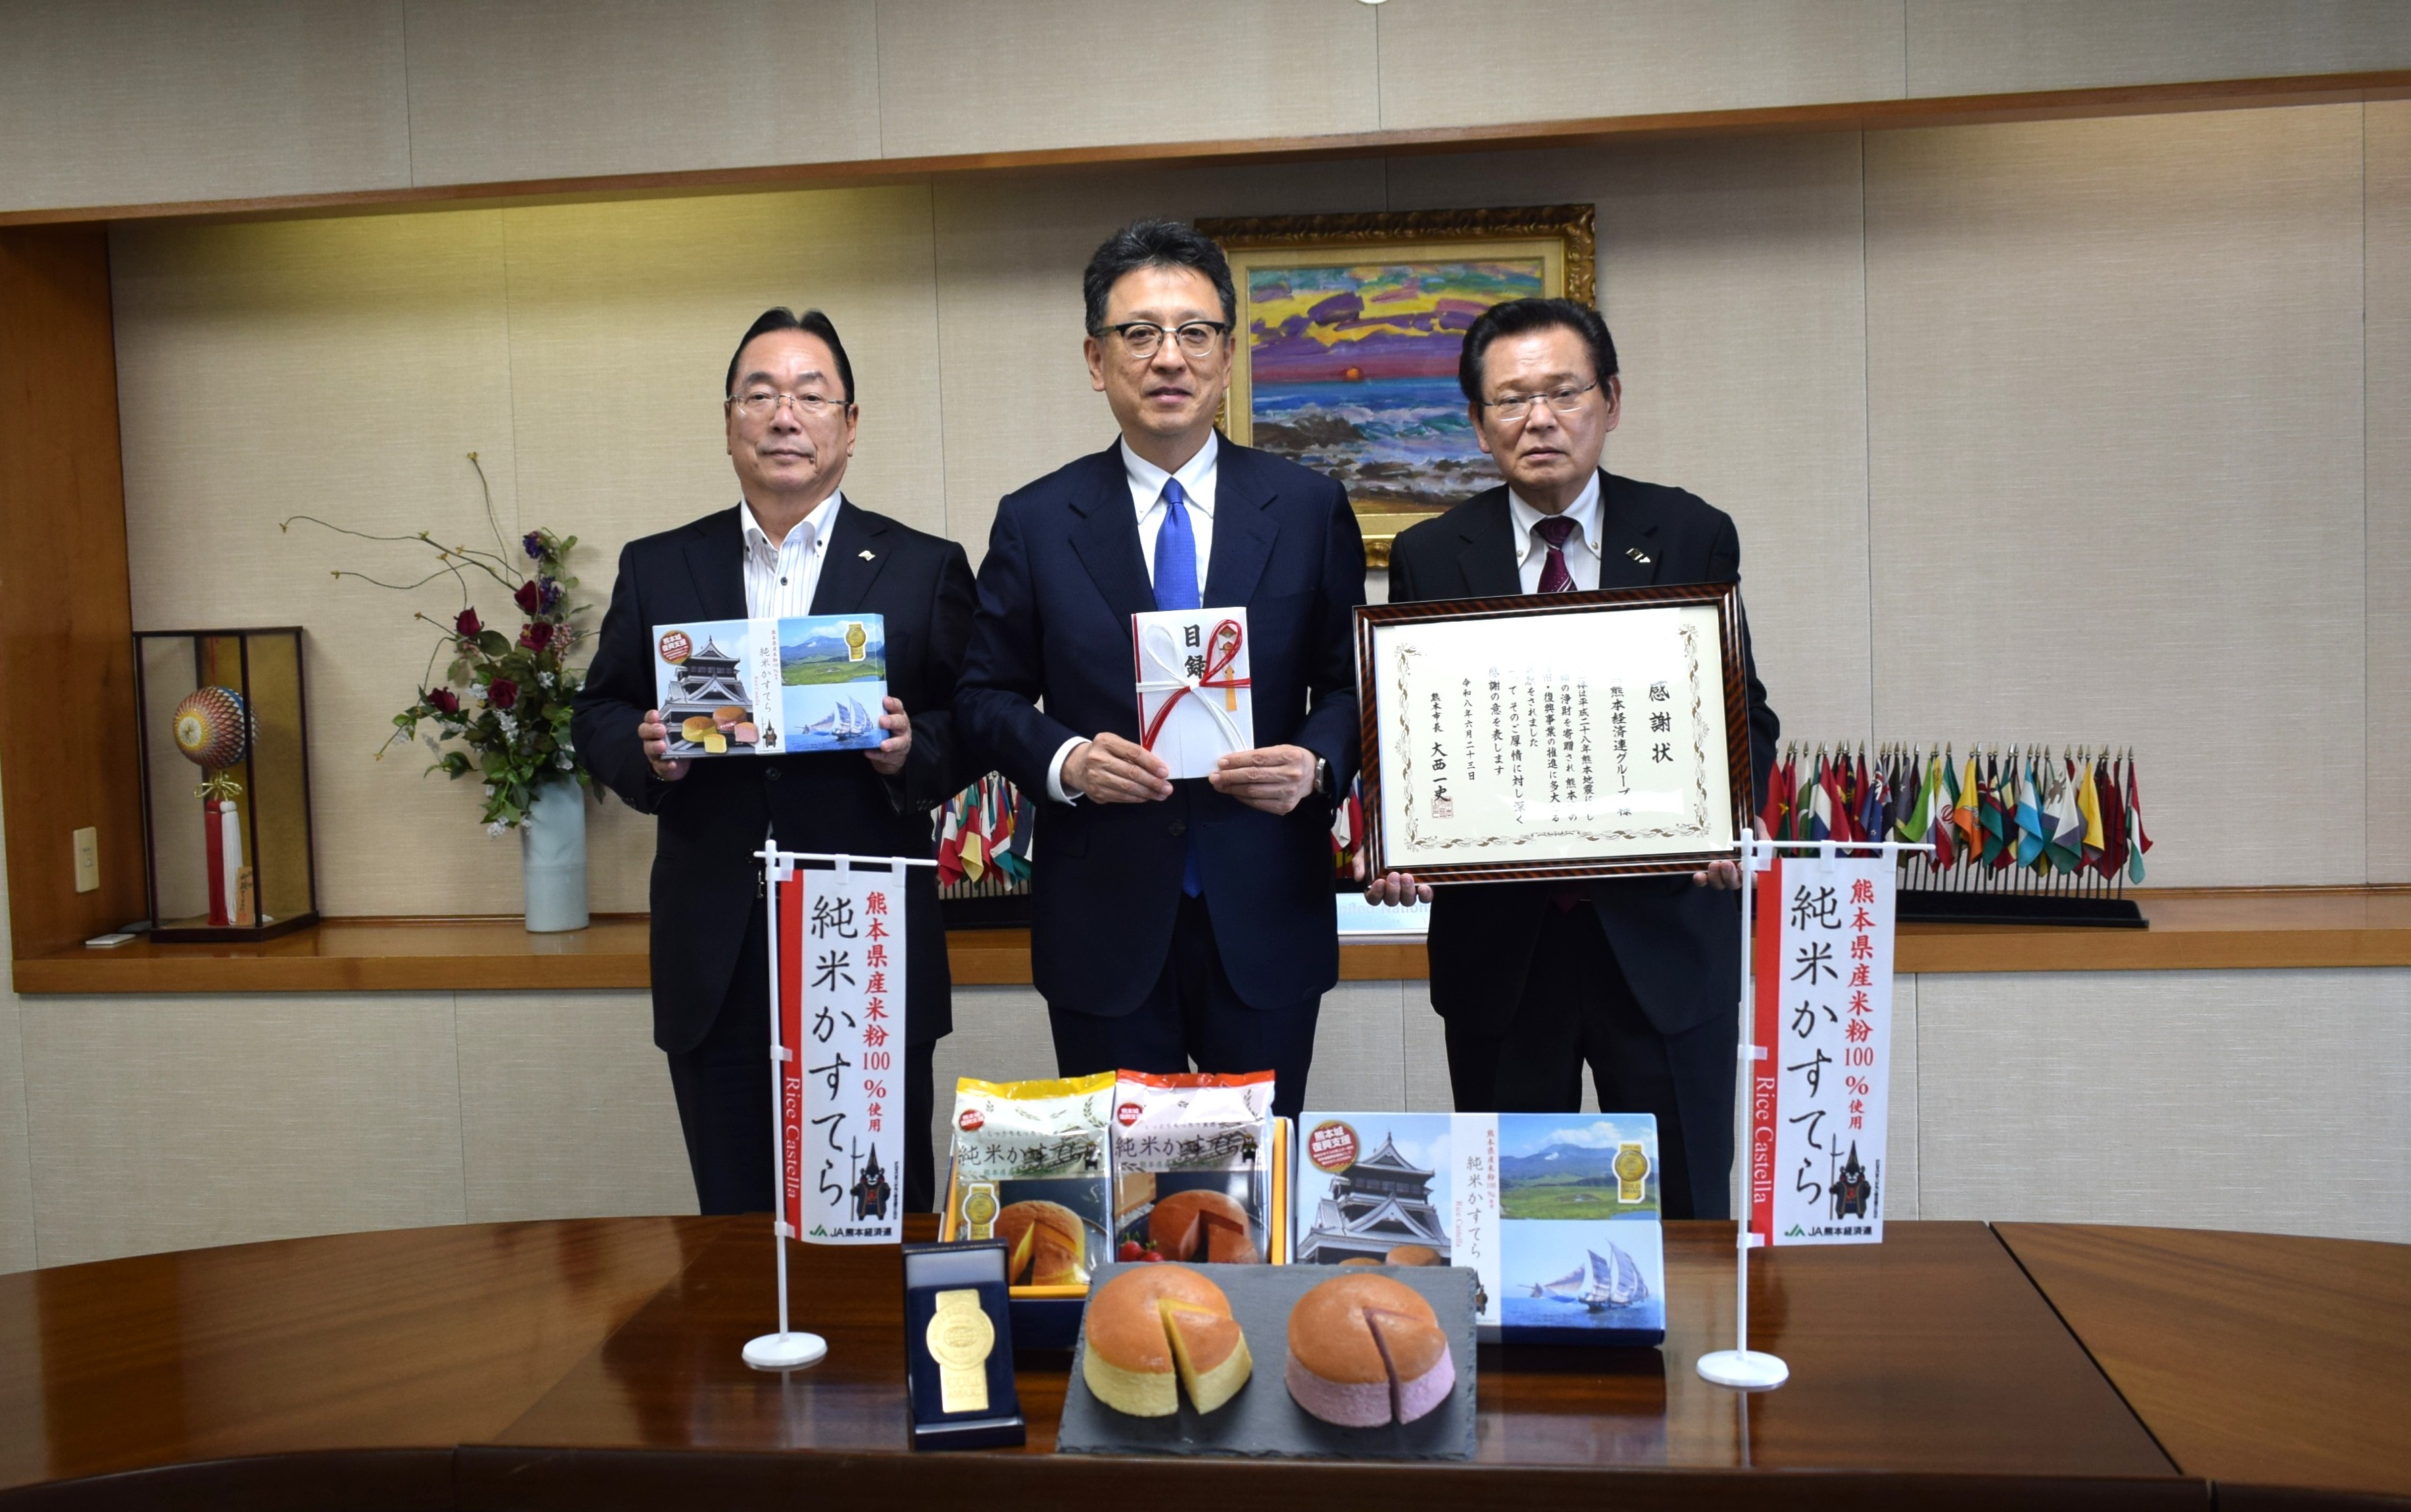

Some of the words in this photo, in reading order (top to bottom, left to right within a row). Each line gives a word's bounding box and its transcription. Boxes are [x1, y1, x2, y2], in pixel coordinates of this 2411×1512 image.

[759, 647, 772, 714] 純米かすてら
[1183, 624, 1208, 679] 目録
[1463, 677, 1476, 781] 令和八年六月二十三日
[1609, 678, 1630, 796] 熊本経済連グループ
[1649, 680, 1674, 764] 感謝状
[1338, 902, 1375, 915] nited
[1381, 902, 1431, 913] Nation
[808, 894, 858, 1207] 純米かすてら
[1786, 884, 1842, 1205] 純米かすてら
[785, 1077, 800, 1121] Rice
[1314, 1126, 1344, 1142] 熊本城
[1755, 1076, 1776, 1121] Rice
[786, 1125, 802, 1199] Castella
[1753, 1125, 1774, 1204] Castella
[1466, 1155, 1484, 1259] 純米かすてら
